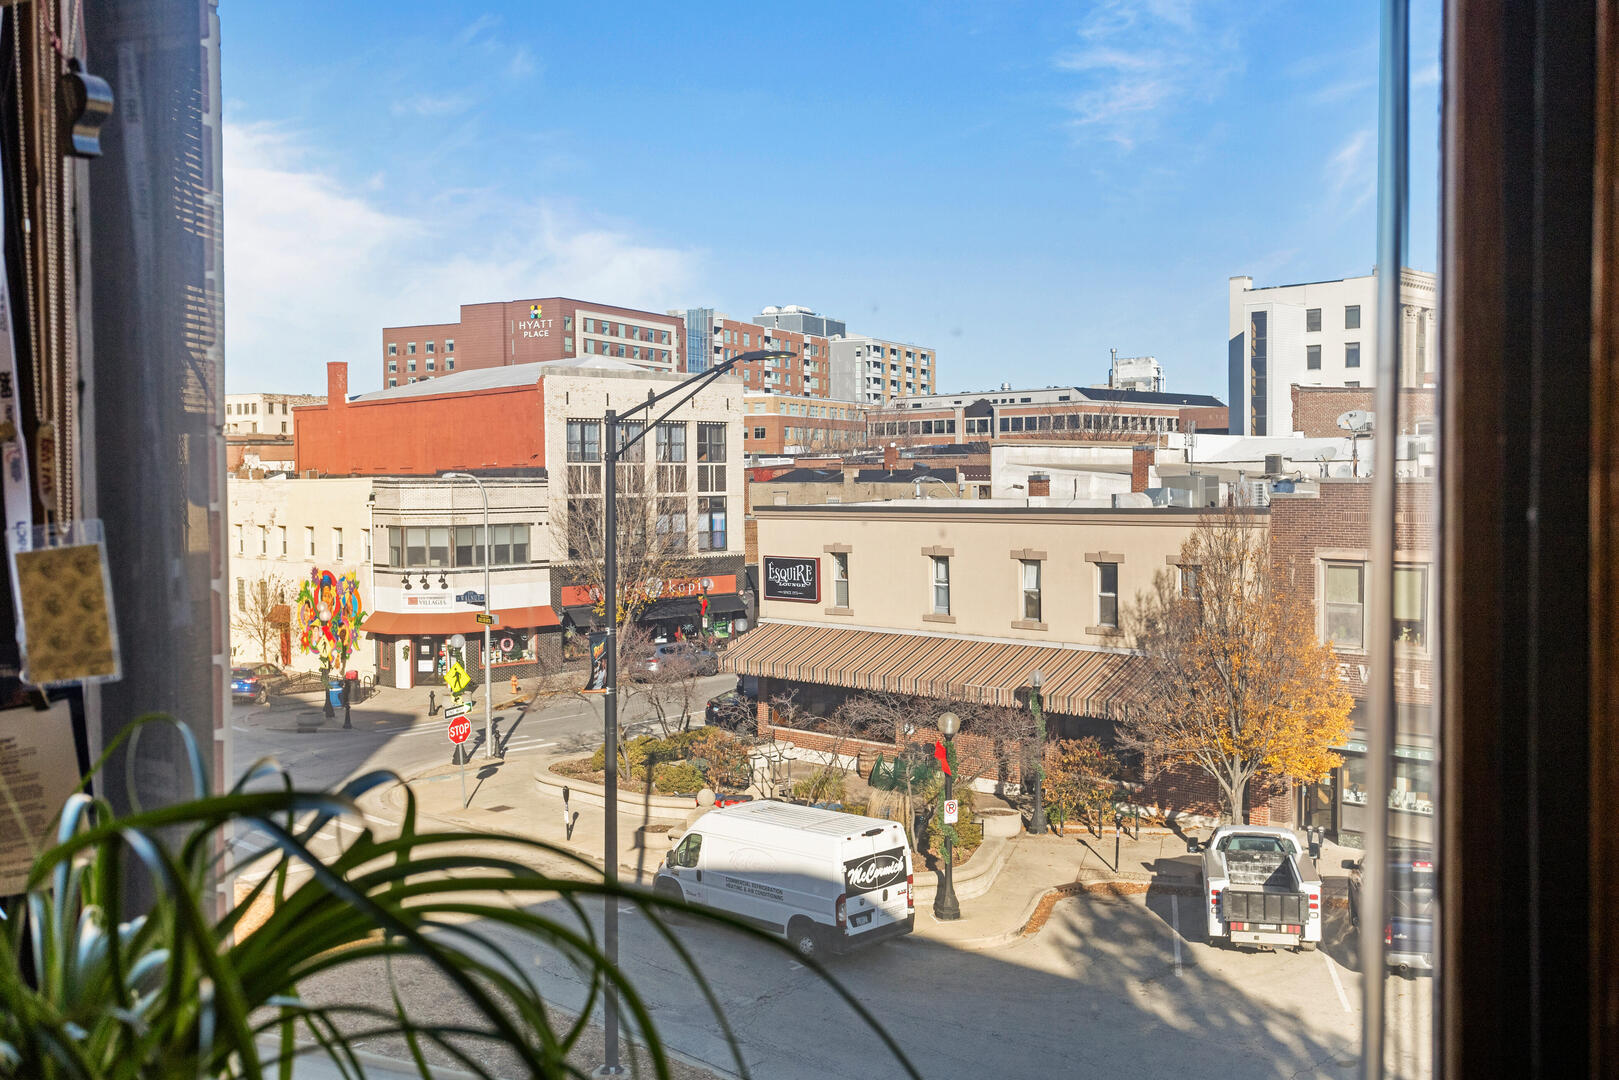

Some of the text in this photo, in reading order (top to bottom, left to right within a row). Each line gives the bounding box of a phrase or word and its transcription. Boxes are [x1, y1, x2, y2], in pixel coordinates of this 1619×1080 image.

[519, 319, 552, 329] HYATT
[523, 329, 549, 338] PLACE
[668, 578, 702, 595] kopi
[450, 722, 470, 738] STOP
[847, 856, 904, 885] McCormick
[725, 876, 784, 895] COMMERCIAL REFRIGERATION
[725, 882, 743, 891] HEATING
[755, 889, 784, 902] CONDITIONING
